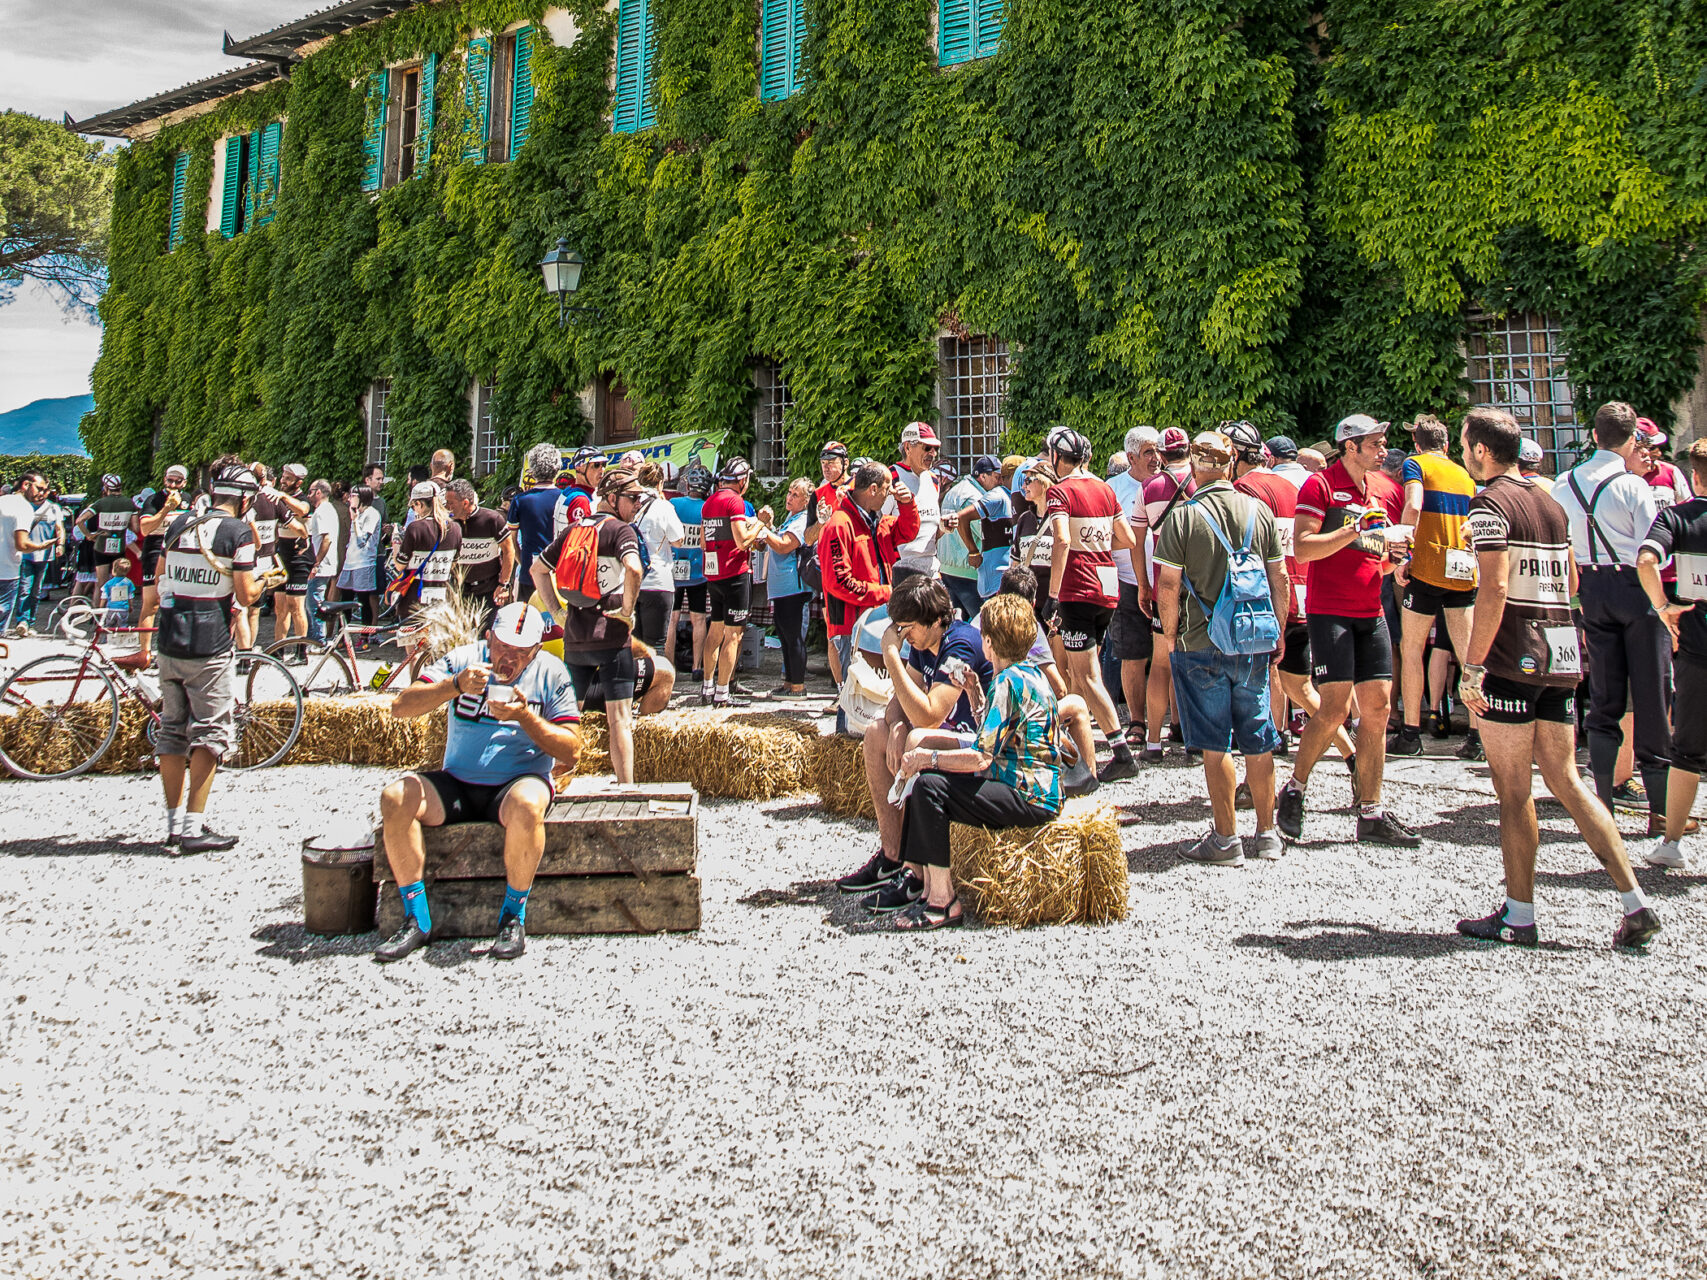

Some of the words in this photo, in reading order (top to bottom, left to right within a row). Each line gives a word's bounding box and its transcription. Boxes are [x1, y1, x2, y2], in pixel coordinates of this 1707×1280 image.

[174, 565, 220, 586] MOLINELLO
[1538, 582, 1568, 593] FIRENZ
[1556, 646, 1577, 663] 368
